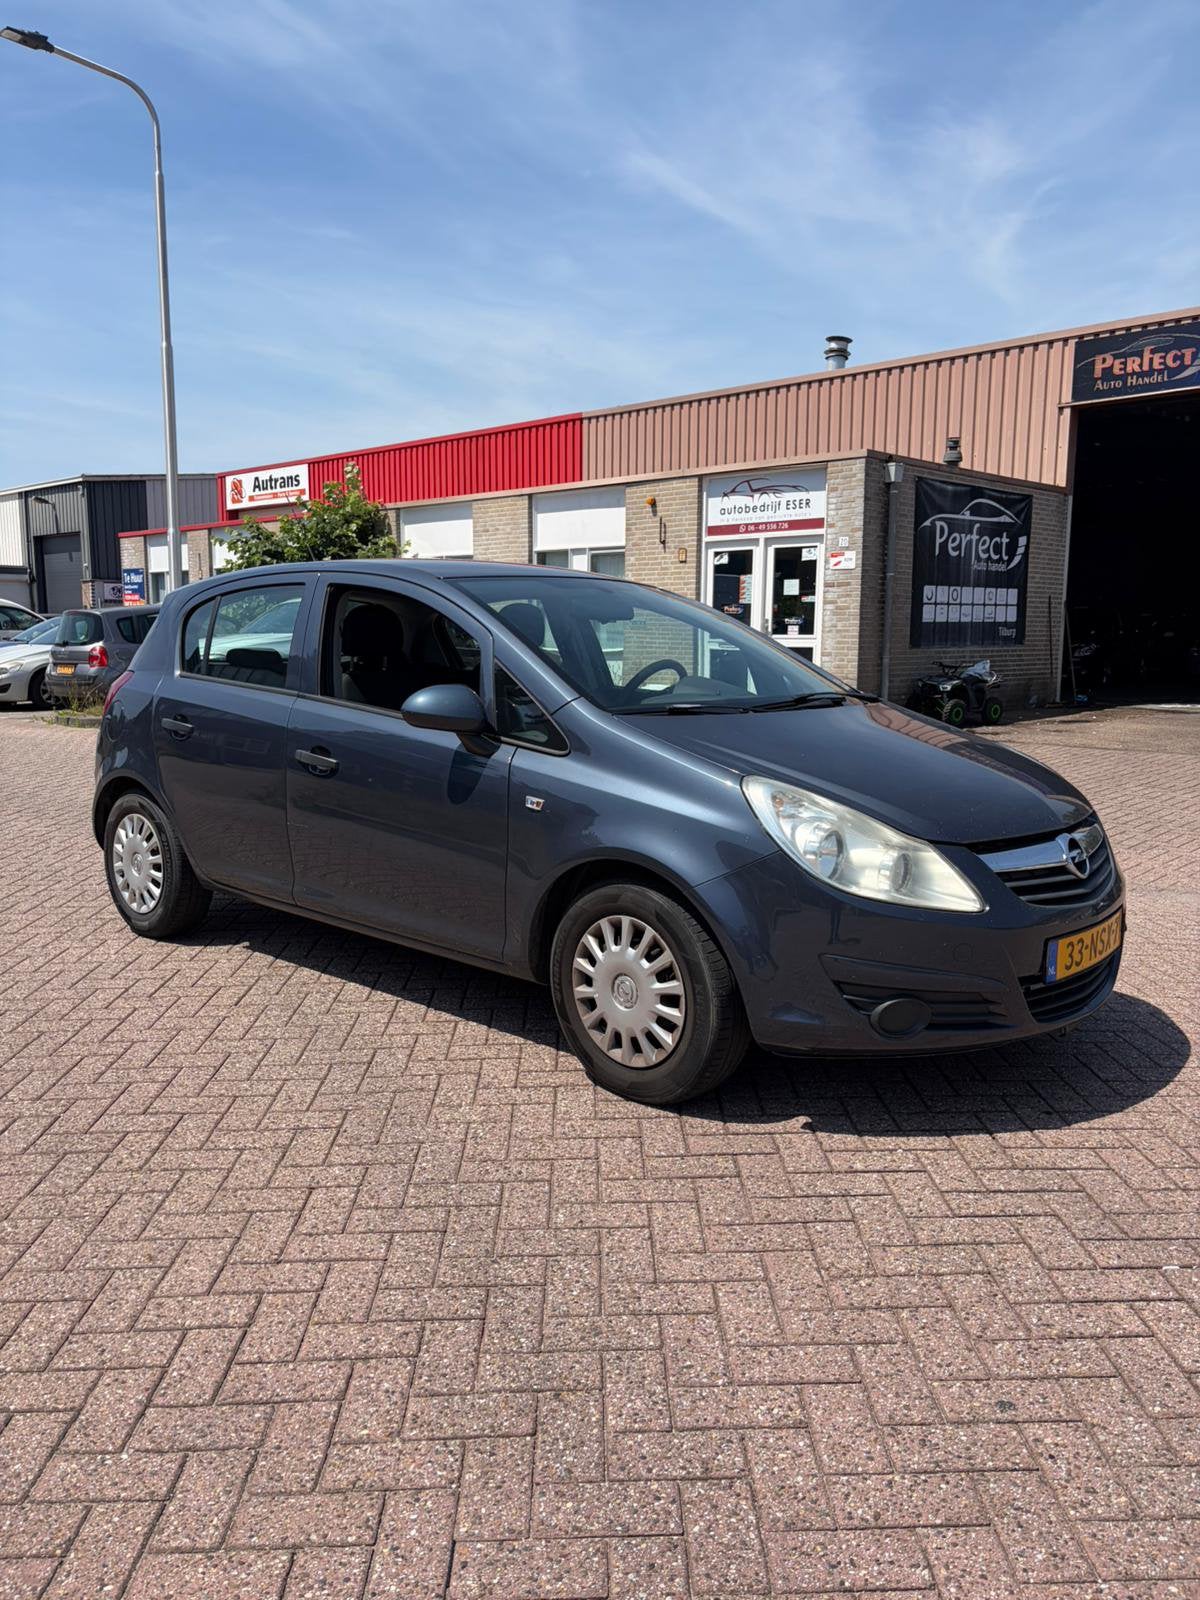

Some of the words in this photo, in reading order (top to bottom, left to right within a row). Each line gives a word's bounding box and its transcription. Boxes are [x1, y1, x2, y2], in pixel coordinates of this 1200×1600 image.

[252, 473, 301, 493] Autrans
[719, 500, 781, 516] autobedrijf
[785, 498, 811, 511] ESER
[935, 520, 1010, 565] Perfect
